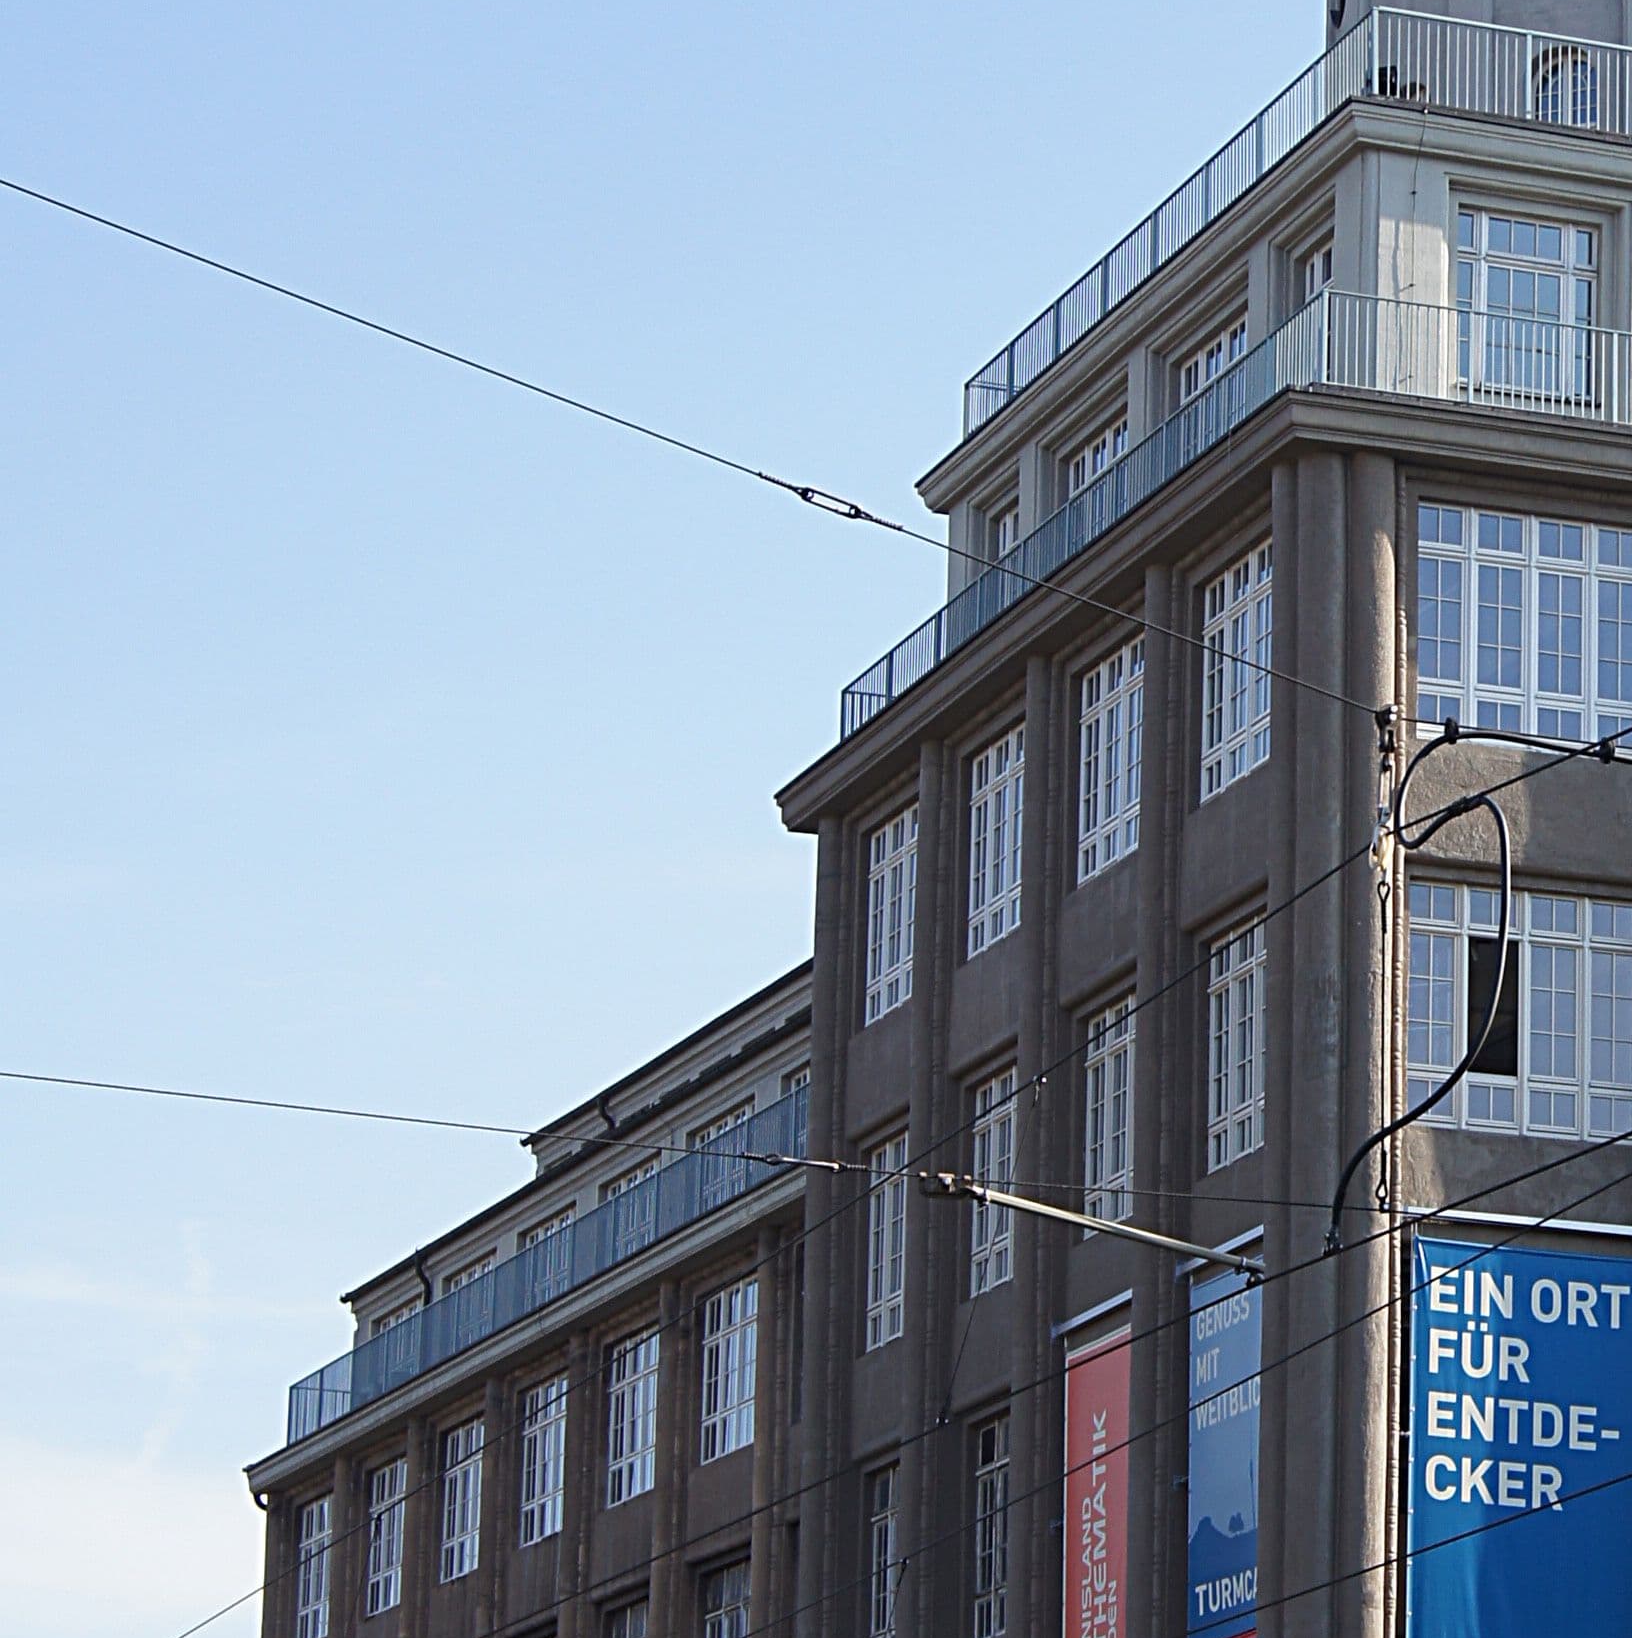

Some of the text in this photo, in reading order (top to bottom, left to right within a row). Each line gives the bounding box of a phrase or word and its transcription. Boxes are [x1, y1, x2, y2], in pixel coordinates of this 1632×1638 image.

[1196, 1293, 1250, 1341] GENUSS
[1430, 1266, 1631, 1329] EIN ORT
[1196, 1347, 1220, 1387] MIT
[1428, 1321, 1530, 1383] FÜR
[1427, 1390, 1620, 1451] ENTDE-
[1425, 1454, 1563, 1511] CKER
